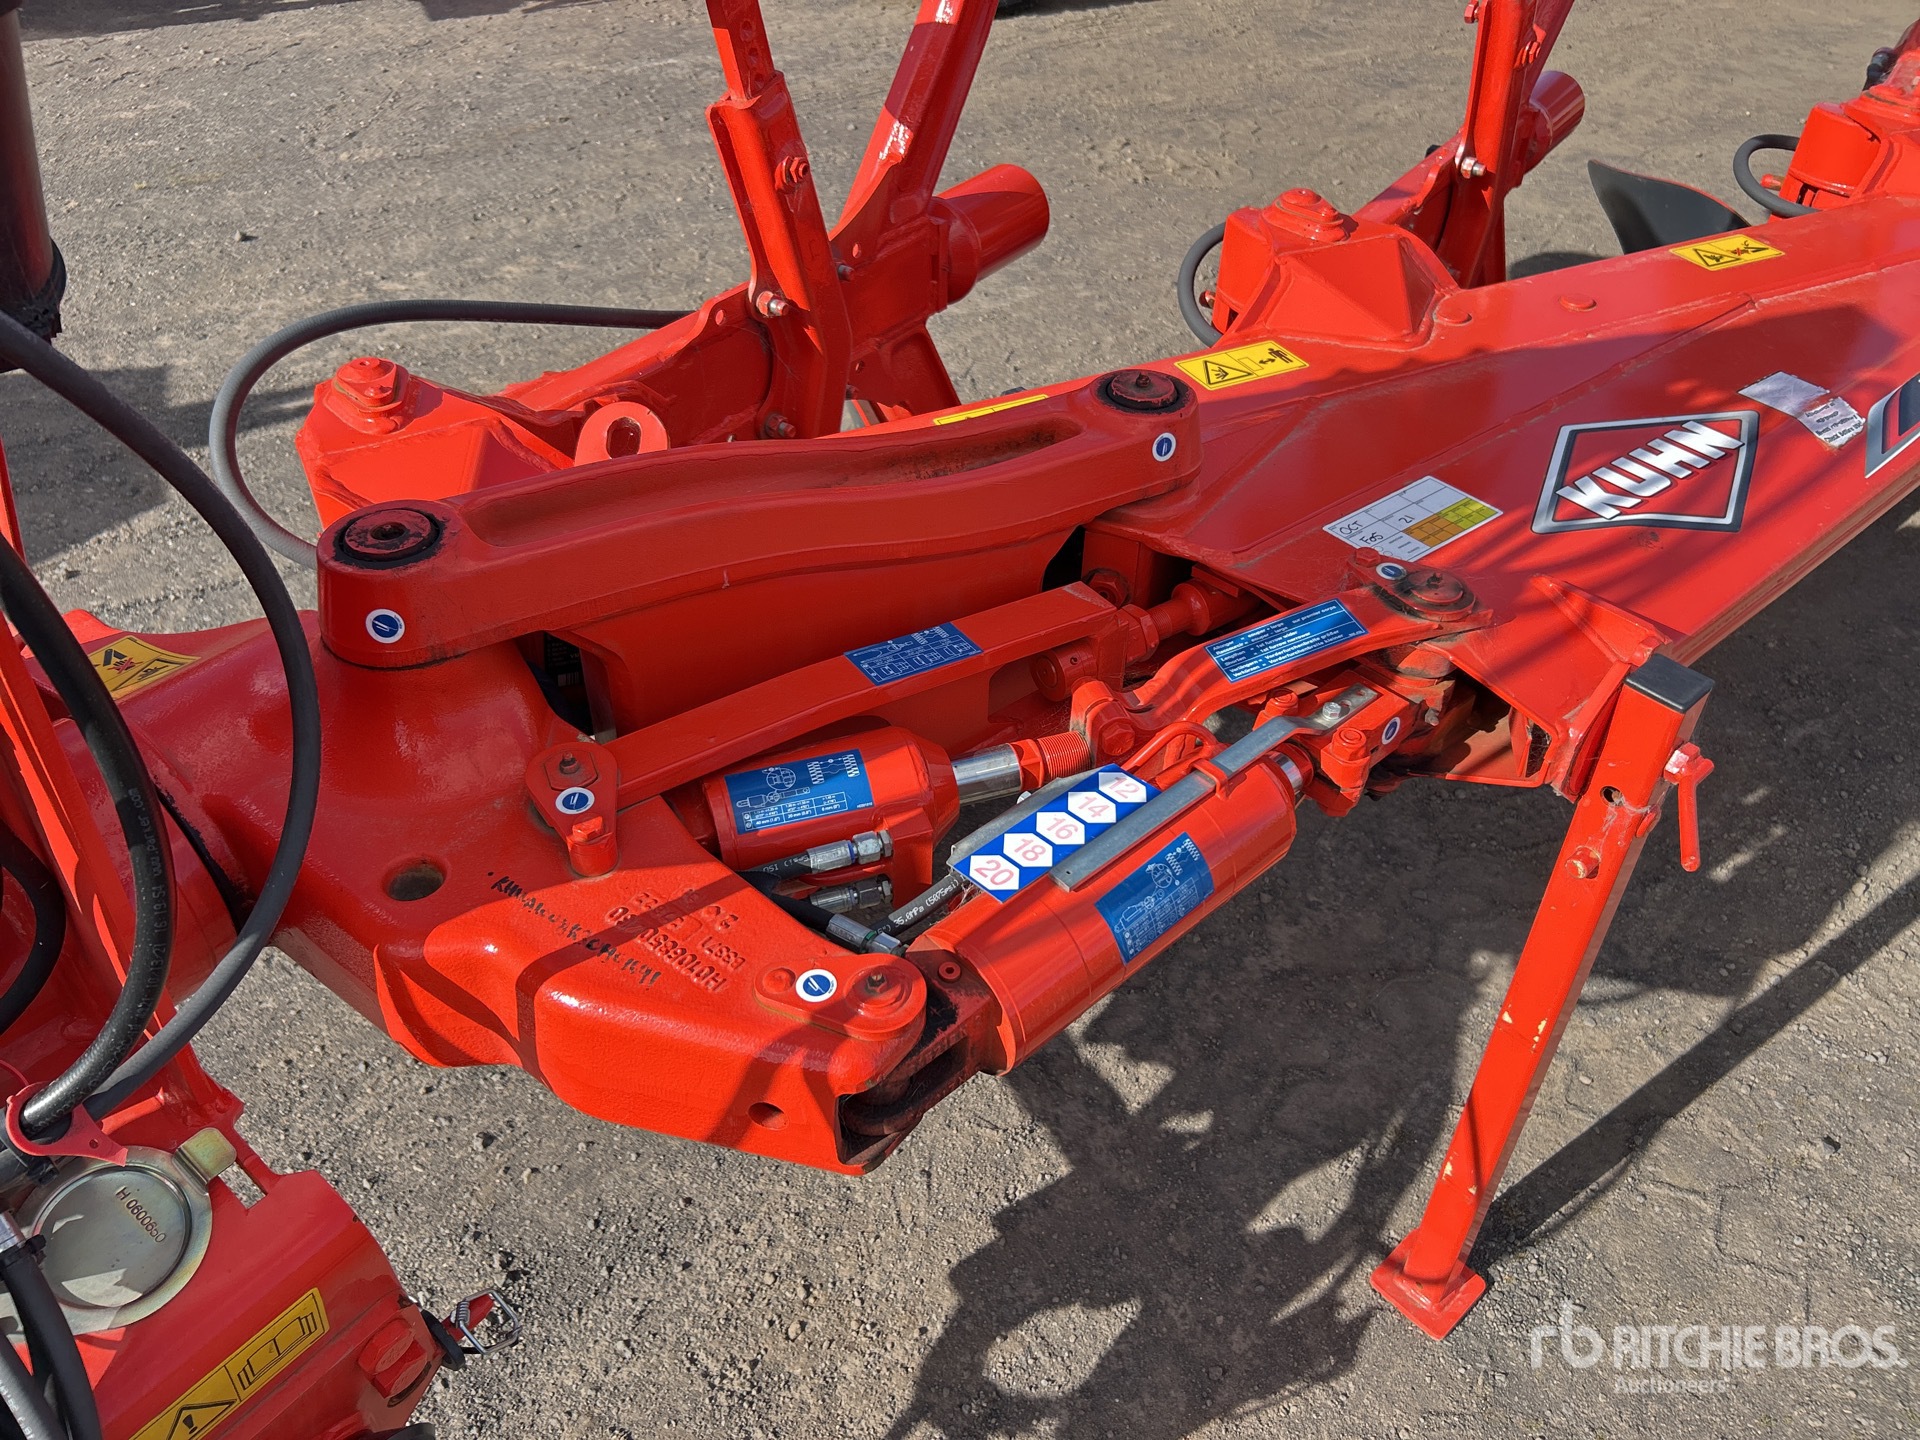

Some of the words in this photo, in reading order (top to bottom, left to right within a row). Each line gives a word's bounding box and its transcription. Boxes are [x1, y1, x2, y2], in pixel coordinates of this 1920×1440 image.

[1556, 420, 1745, 520] KUHN
[1221, 650, 1246, 662] Lengthen
[1265, 637, 1283, 646] furrow
[1283, 630, 1298, 639] wider
[1225, 656, 1246, 667] Shorten
[1269, 641, 1287, 650] furrow
[1287, 632, 1311, 643] narrower
[1324, 634, 1344, 643] kleiner
[974, 859, 1014, 886] 20
[1013, 837, 1046, 862] 18
[1046, 816, 1078, 840] 16
[1078, 795, 1109, 818] 14
[1108, 776, 1140, 799] 12
[115, 1186, 131, 1200] H
